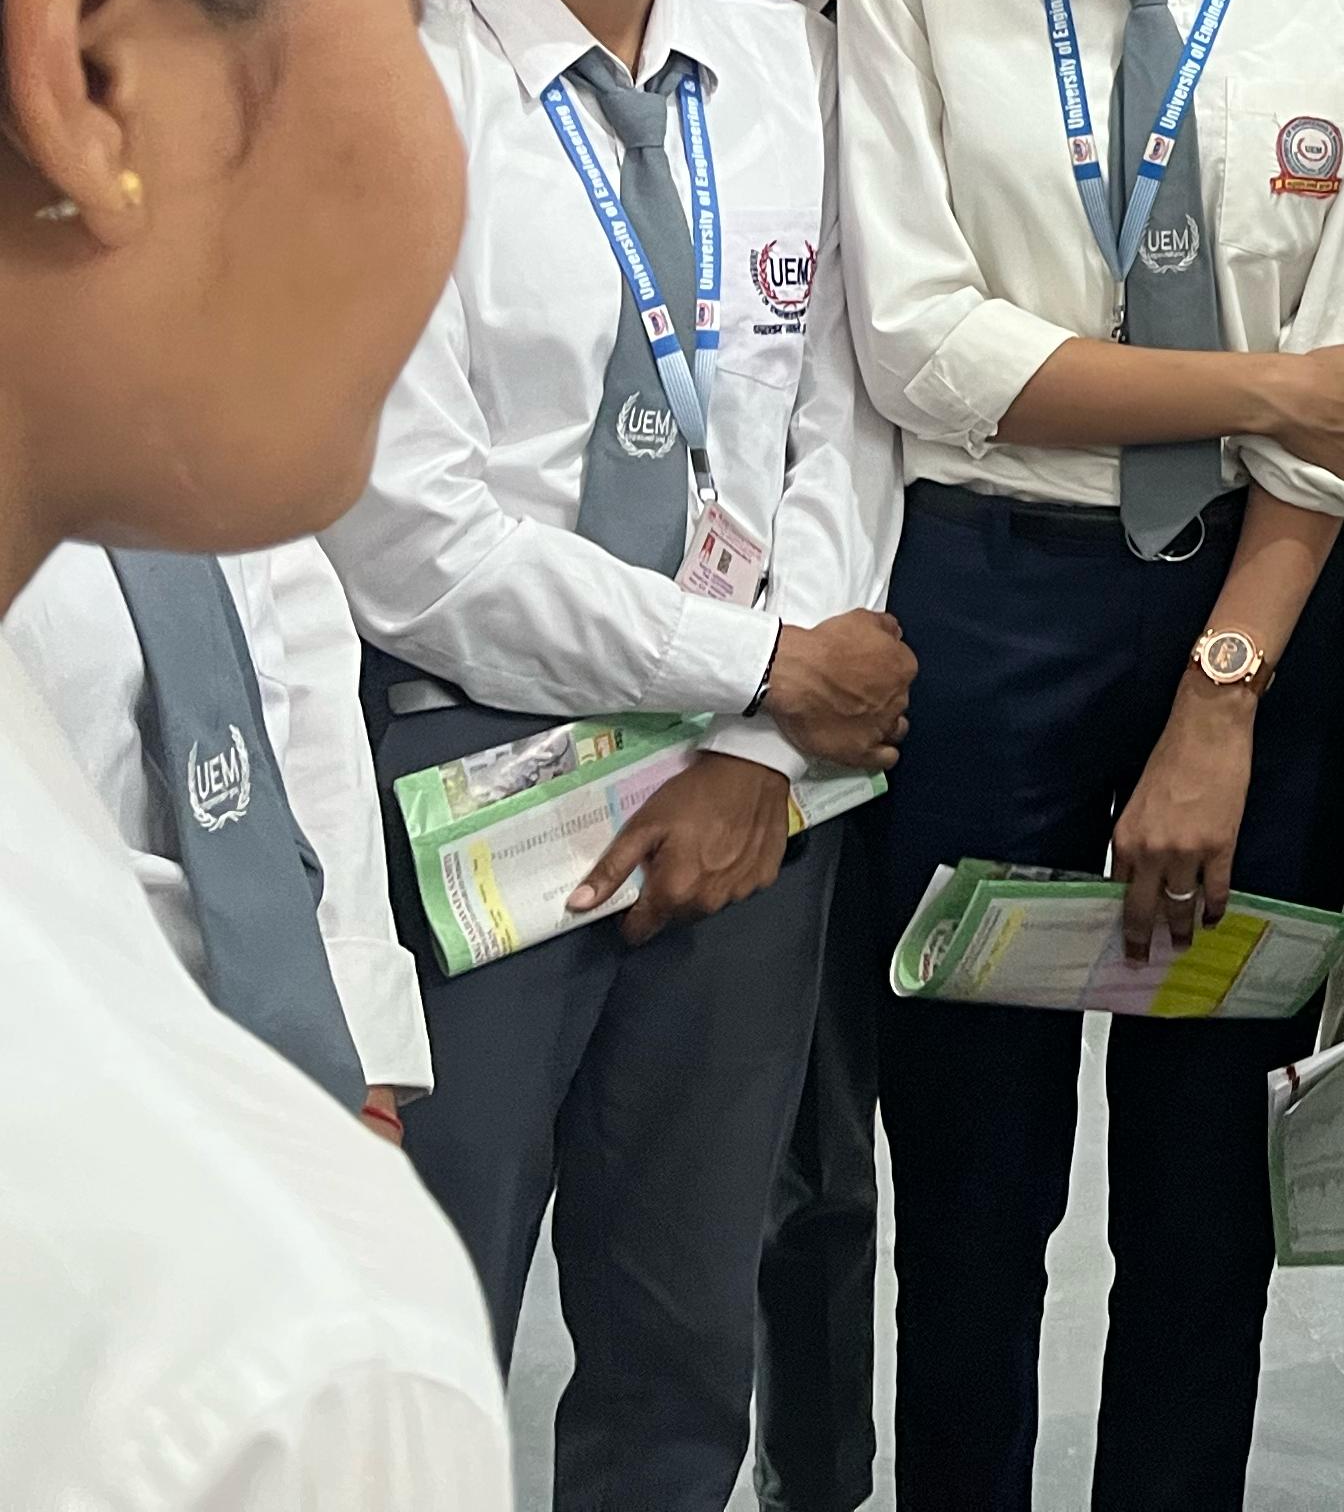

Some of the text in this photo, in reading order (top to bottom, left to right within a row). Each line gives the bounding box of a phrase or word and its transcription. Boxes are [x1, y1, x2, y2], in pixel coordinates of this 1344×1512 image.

[1060, 59, 1085, 130] University
[1159, 58, 1201, 130] University
[1191, 41, 1207, 60] of
[687, 96, 710, 187] Engineering
[547, 89, 655, 300] University of Engineering &
[697, 190, 711, 206] of
[699, 210, 714, 290] University
[1147, 226, 1189, 252] UEM
[769, 257, 809, 287] UEM
[628, 405, 671, 436] UEM
[196, 747, 240, 800] UEM
